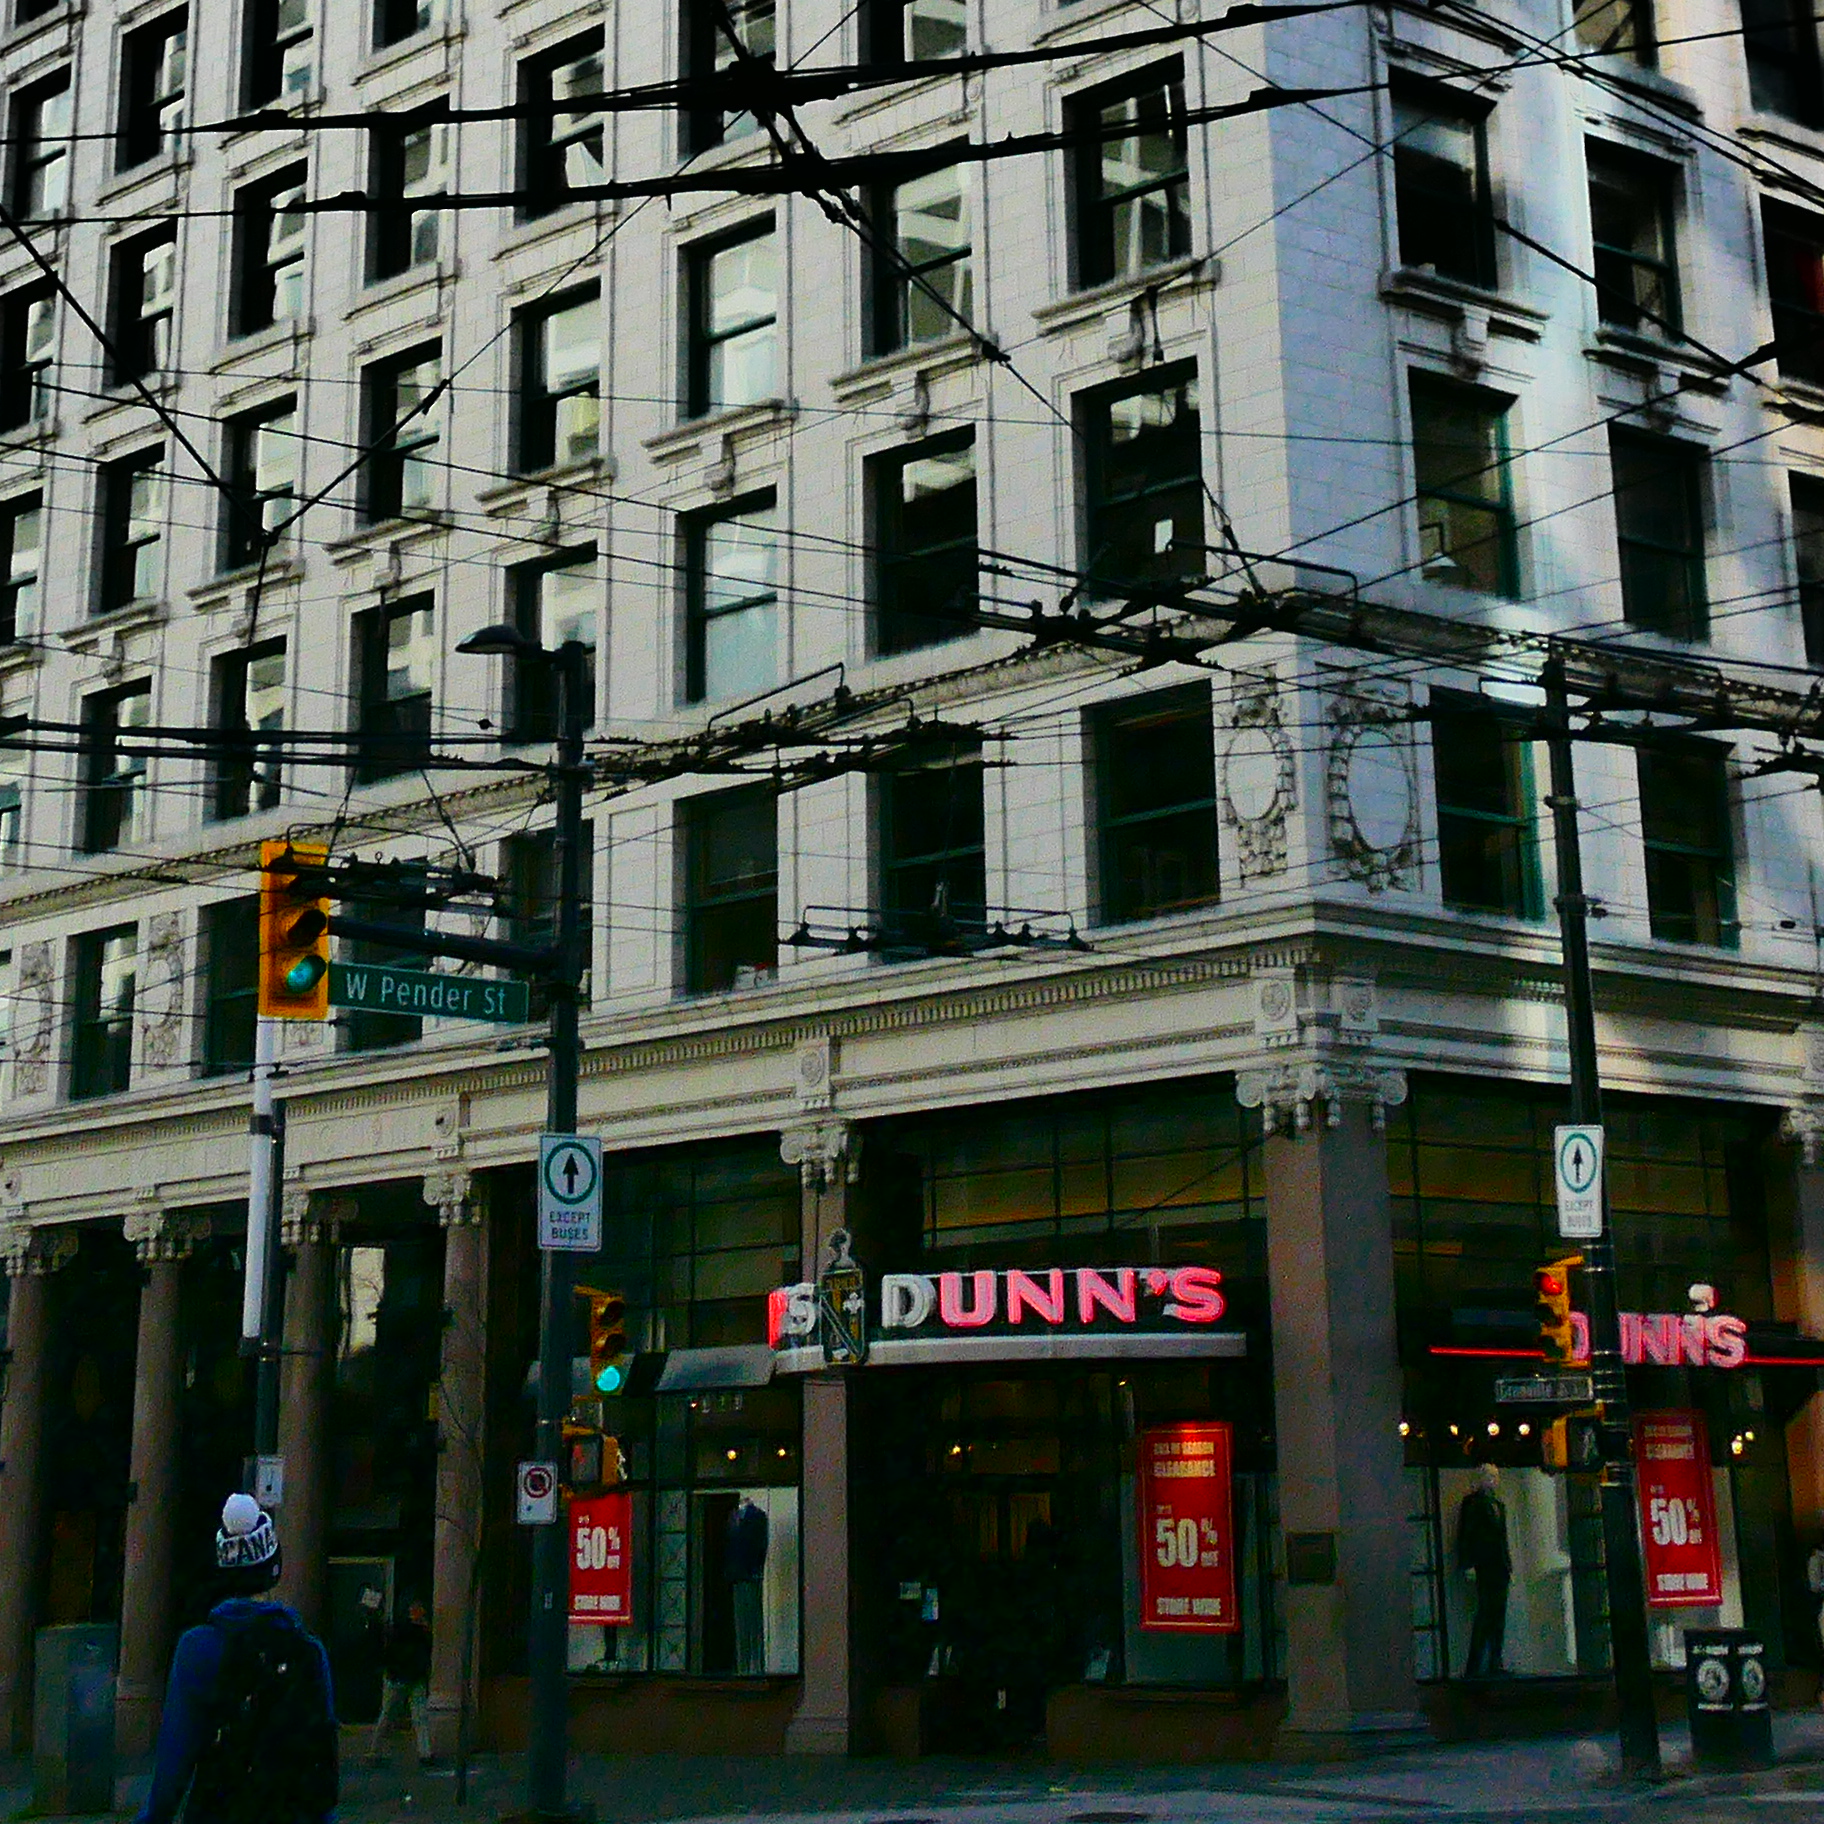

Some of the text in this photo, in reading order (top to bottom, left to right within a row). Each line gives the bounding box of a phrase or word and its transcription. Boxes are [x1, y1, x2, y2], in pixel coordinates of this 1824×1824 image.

[346, 972, 505, 1015] W Pender St
[549, 1210, 591, 1224] EXCEPT
[551, 1226, 589, 1240] BUSES
[880, 1265, 1229, 1330] DUNN'S
